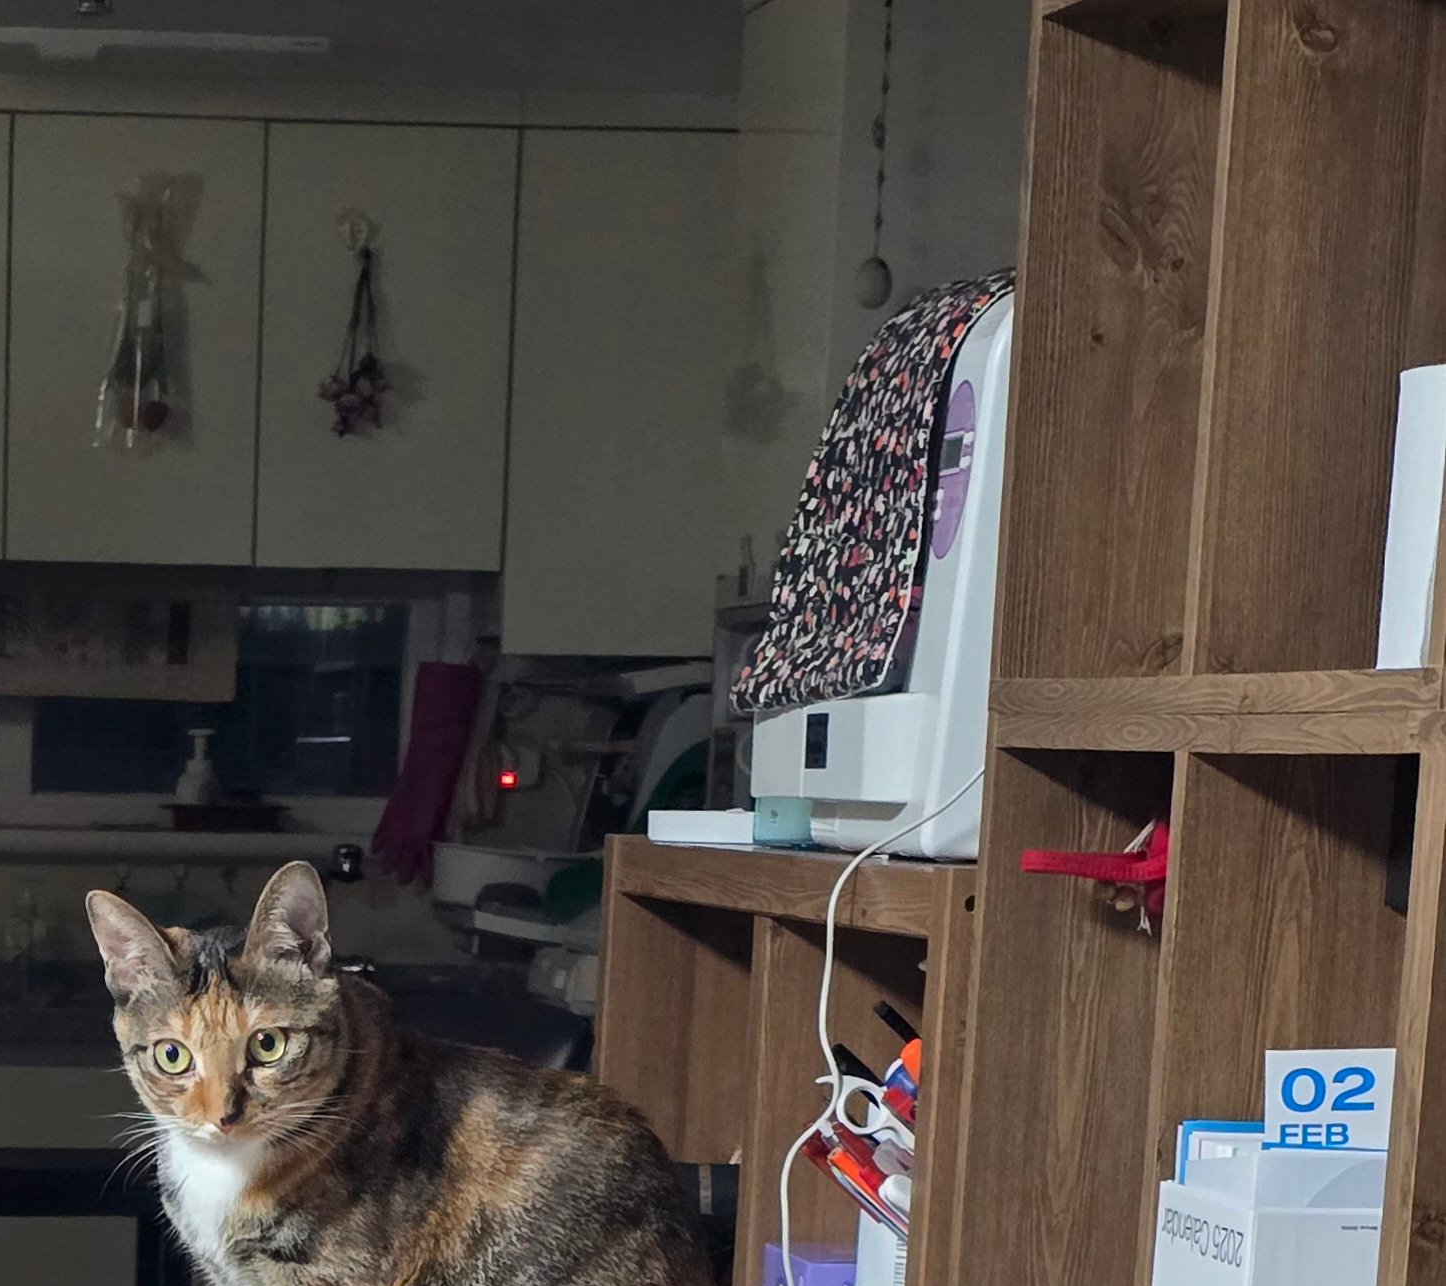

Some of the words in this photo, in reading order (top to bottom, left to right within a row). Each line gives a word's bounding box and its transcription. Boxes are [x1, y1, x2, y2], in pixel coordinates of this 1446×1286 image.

[1281, 1067, 1376, 1112] 02
[1280, 1123, 1349, 1147] FEB
[1162, 1207, 1210, 1257] Calendar
[1212, 1225, 1244, 1268] 2025
